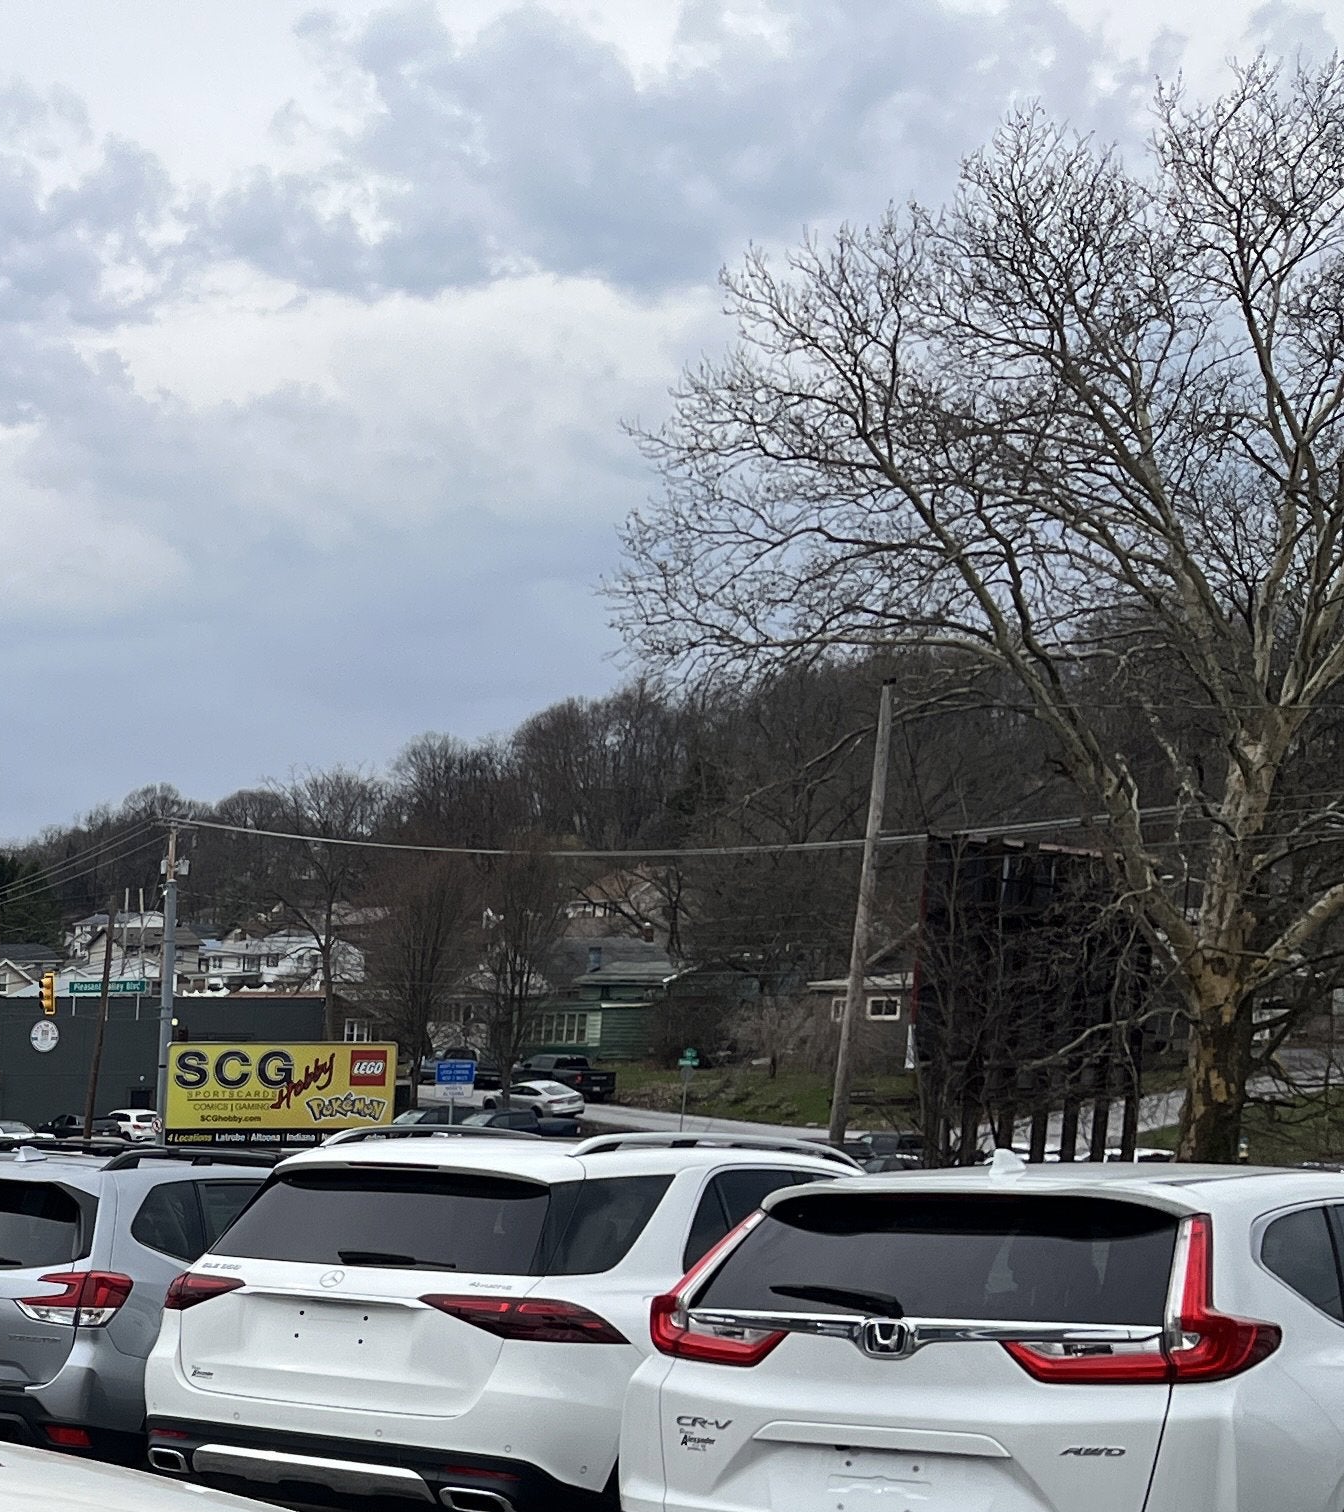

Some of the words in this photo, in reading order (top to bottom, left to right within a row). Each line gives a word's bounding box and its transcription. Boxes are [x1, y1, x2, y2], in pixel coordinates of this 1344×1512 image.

[174, 1050, 294, 1090] SCG
[351, 1058, 385, 1076] LEGO
[270, 1053, 335, 1109] Hobby
[199, 1114, 262, 1123] SCGhobby.com
[174, 1134, 212, 1143] Locations
[676, 1416, 732, 1430] CR-V
